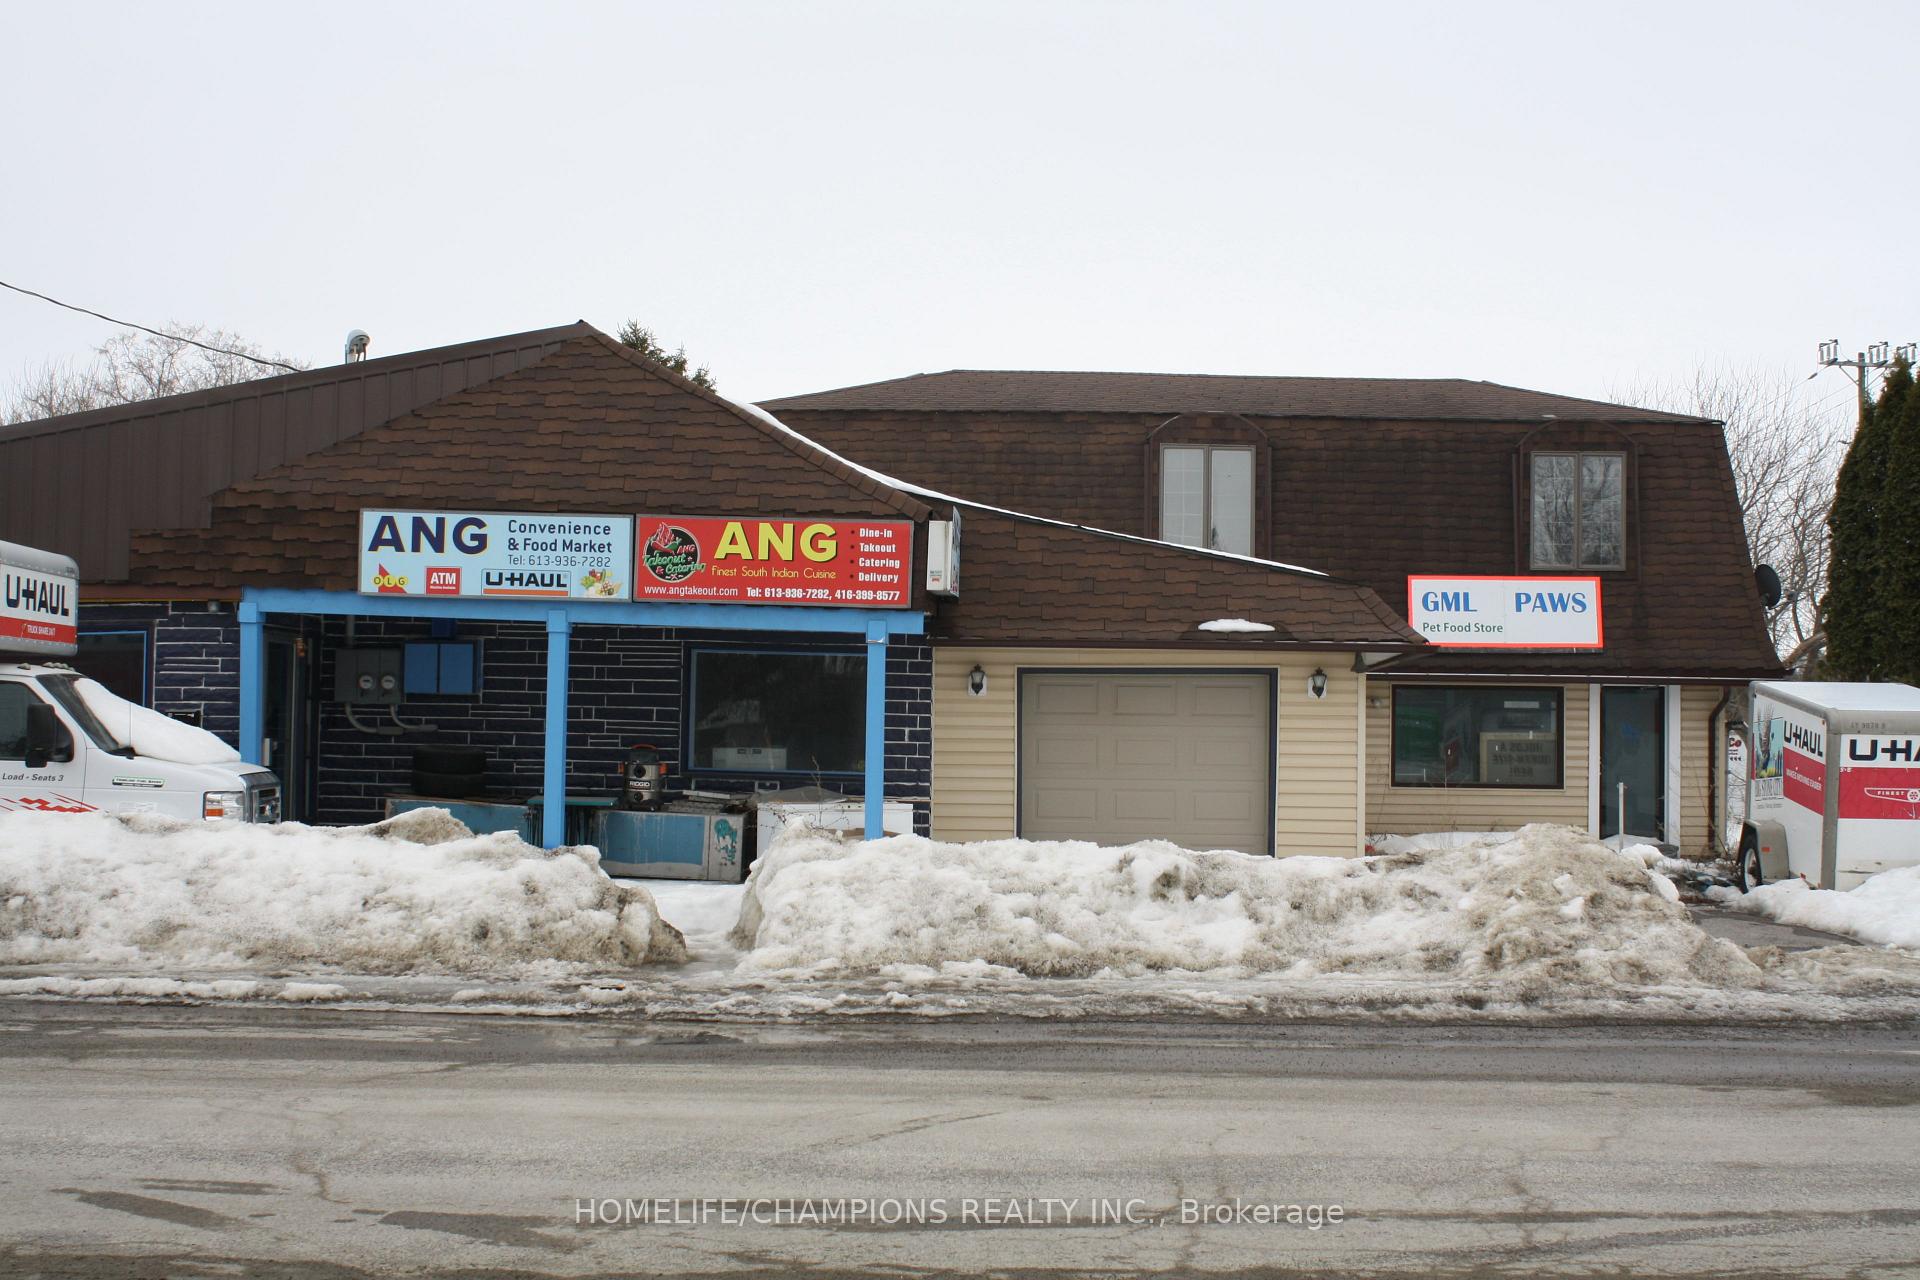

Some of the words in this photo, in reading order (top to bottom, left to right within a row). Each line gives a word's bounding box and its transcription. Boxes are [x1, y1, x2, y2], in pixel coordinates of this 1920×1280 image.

[508, 519, 612, 535] Convenience
[859, 528, 893, 538] Dine-in
[367, 515, 489, 555] ANG
[713, 521, 838, 563] ANG
[507, 537, 519, 551] &
[523, 538, 558, 552] Food
[562, 539, 612, 553] Market
[860, 543, 896, 553] Takeout
[508, 554, 526, 566] Tel:
[528, 554, 611, 568] 613-936-7282
[643, 551, 687, 568] Takeout
[858, 557, 900, 569] Catering
[430, 572, 457, 585] ATM
[711, 565, 737, 577] Finest
[741, 565, 767, 577] South
[772, 567, 798, 578] Indian
[803, 567, 837, 579] Cuisine
[858, 572, 899, 584] Delivery
[644, 584, 738, 598] www.angtakeout.com
[747, 587, 762, 598] Tel:
[764, 587, 832, 601] 613-936-7282,
[834, 588, 901, 601] 416-399-8577
[1421, 591, 1478, 613] GML
[1514, 592, 1588, 614] PAWS
[1422, 622, 1441, 633] Pet
[1443, 622, 1472, 633] Food
[1473, 622, 1504, 633] Store
[2, 773, 25, 781] Load
[31, 773, 56, 782] Seats
[58, 774, 65, 782] 3
